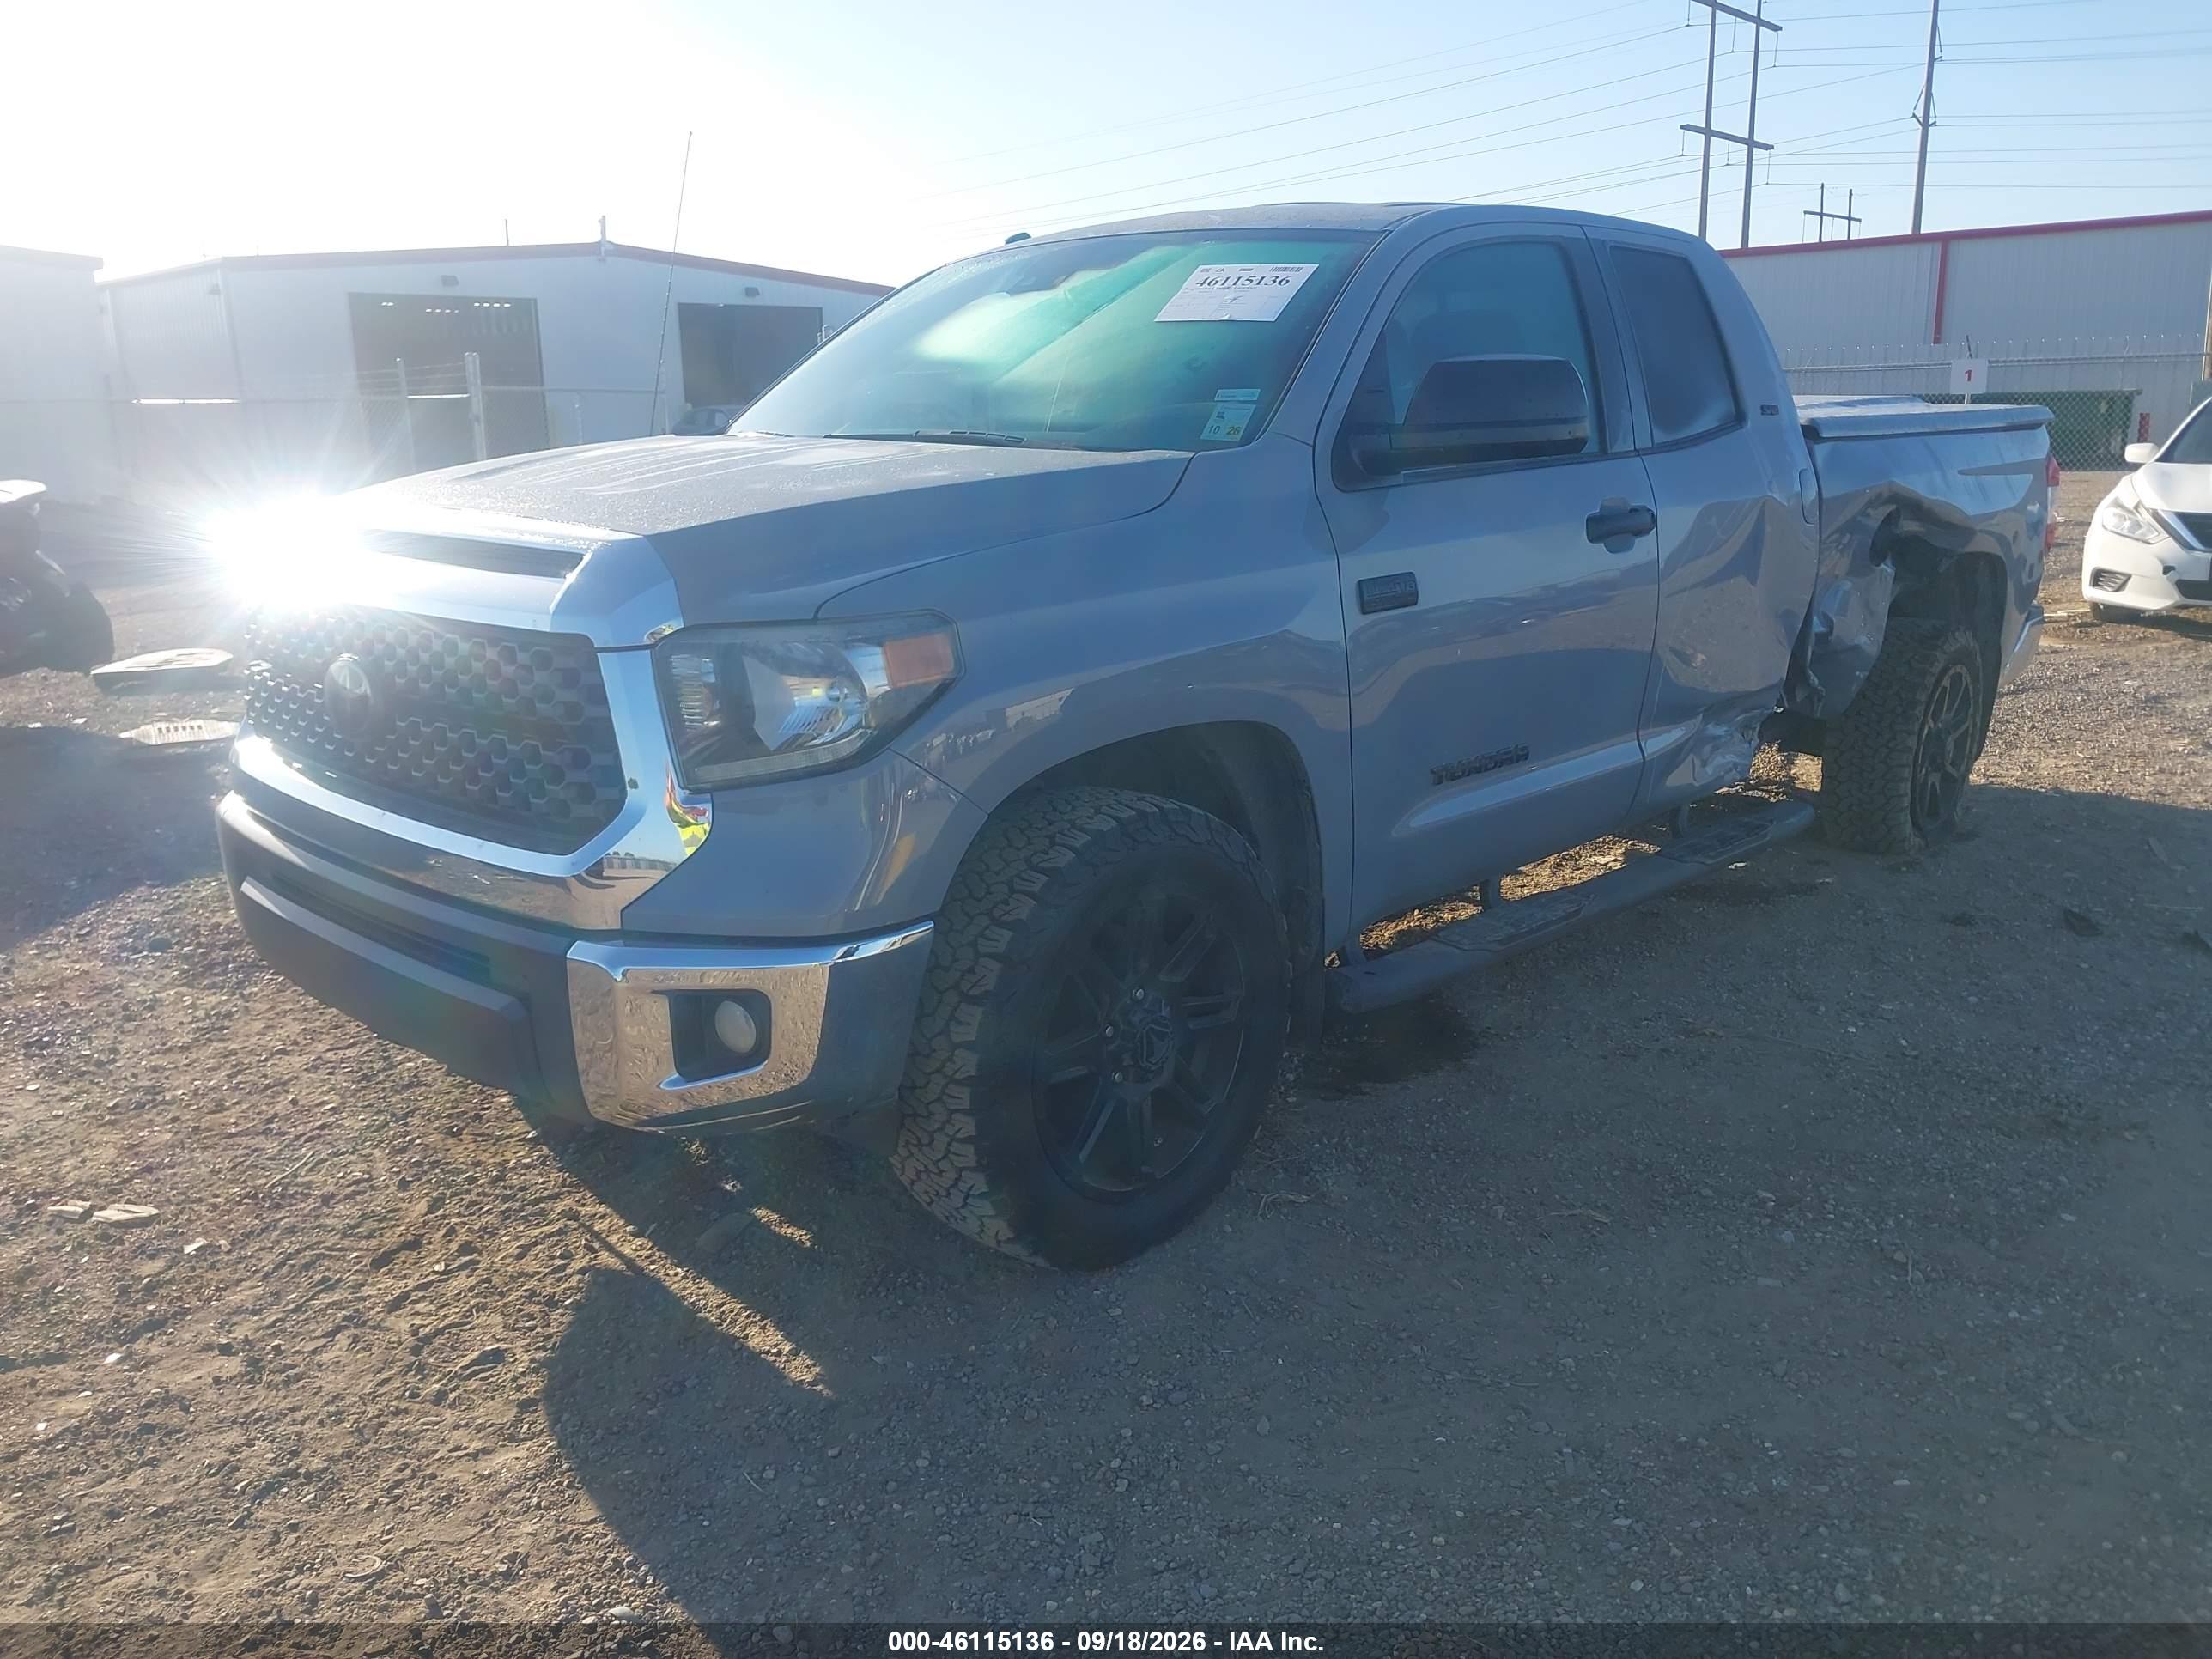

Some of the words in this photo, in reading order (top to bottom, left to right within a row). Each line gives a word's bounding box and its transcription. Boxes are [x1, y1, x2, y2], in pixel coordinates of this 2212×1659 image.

[1195, 275, 1292, 288] 46115136
[1964, 369, 1972, 382] 1
[1208, 425, 1221, 434] 10
